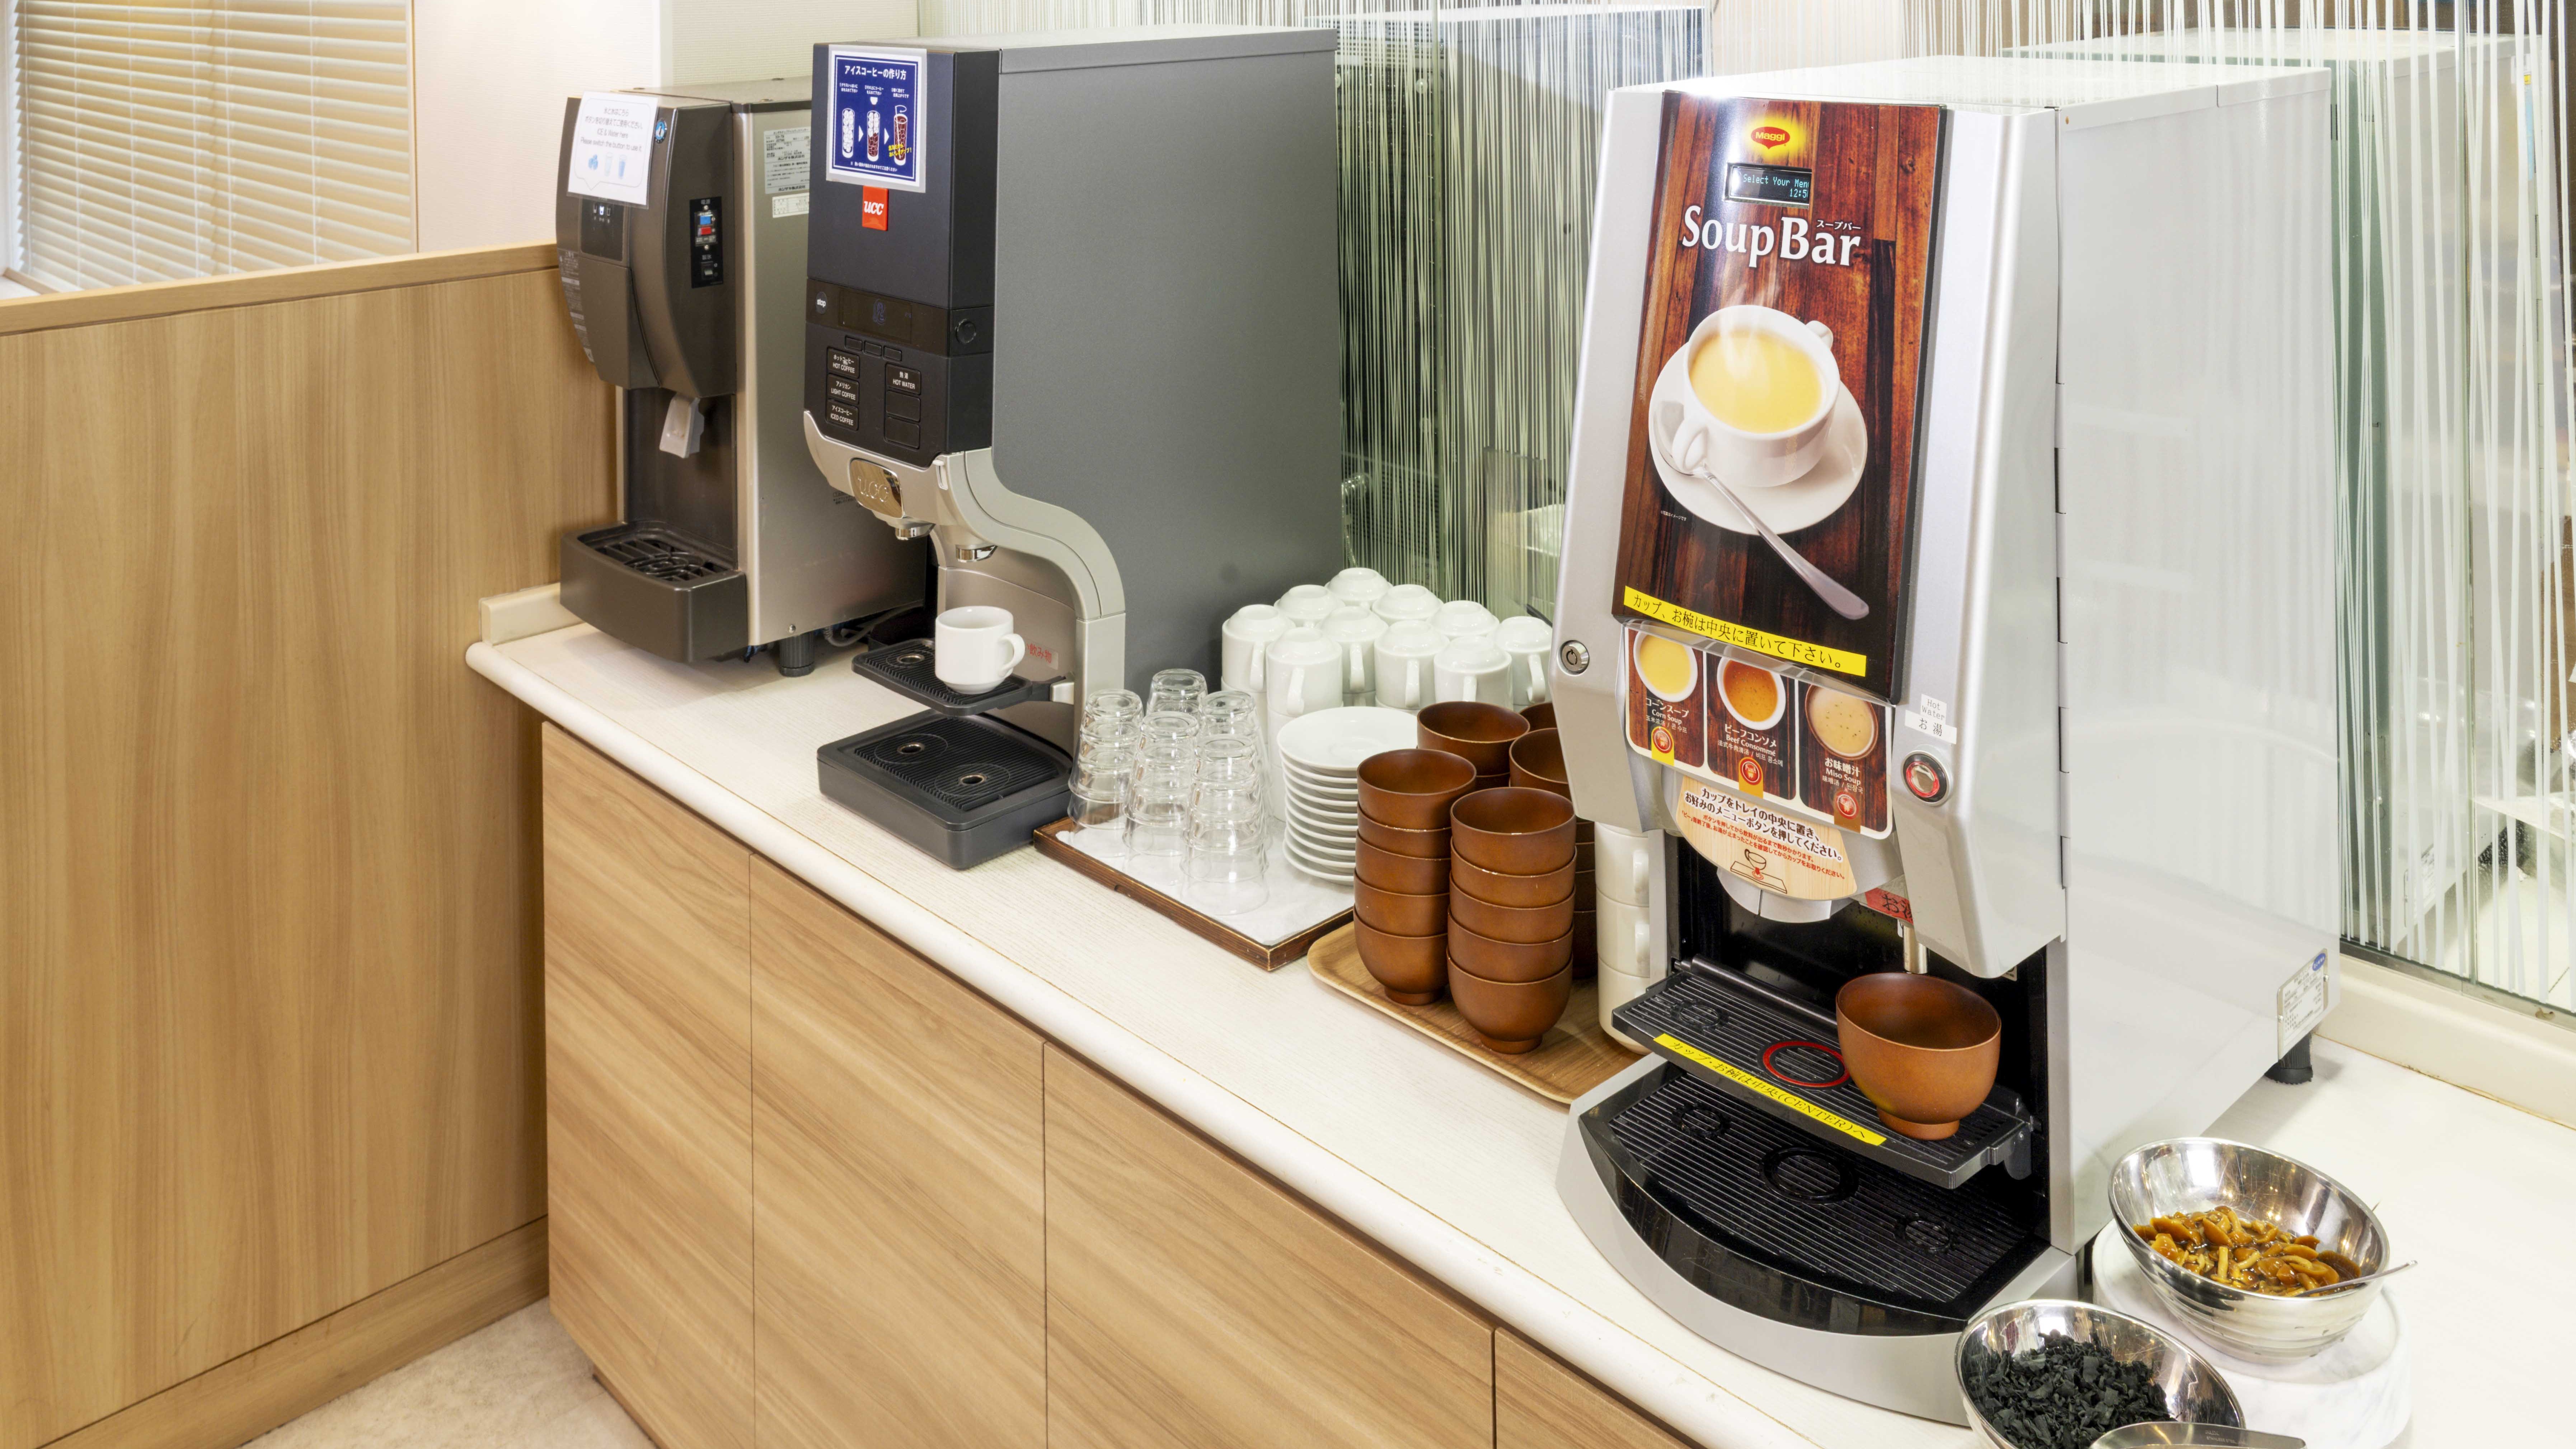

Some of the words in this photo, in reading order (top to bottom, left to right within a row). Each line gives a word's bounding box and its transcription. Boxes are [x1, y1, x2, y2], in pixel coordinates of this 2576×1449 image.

[845, 65, 907, 80] アイスコーヒーの作り方
[1743, 174, 1769, 184] Select
[1773, 176, 1790, 187] Your
[1794, 179, 1809, 188] Men
[1790, 188, 1808, 198] 12:5
[864, 201, 884, 215] UCC
[1816, 220, 1861, 230] スープバー
[1682, 205, 1774, 268] Soup
[1780, 216, 1861, 266] Bar
[817, 299, 826, 308] stop
[833, 354, 854, 364] ホットコーヒー
[841, 365, 855, 373] COFFEE
[836, 381, 851, 390] アメリカン
[901, 381, 915, 389] WATER
[841, 391, 856, 400] COFFEE
[832, 405, 853, 416] アイスコーヒー
[839, 416, 854, 426] COFFEE
[1633, 594, 1841, 669] カップ、お椀は中央に置いて下さい。
[1646, 697, 1689, 718] コーンスープ
[1927, 698, 1941, 711] Hot
[1652, 709, 1666, 719] Corn
[1667, 714, 1682, 725] Soup
[1922, 705, 1945, 720] Water
[1678, 726, 1688, 734] 수프
[1919, 718, 1942, 736] お湯
[1725, 723, 1777, 747] ビーフコンソメ
[1726, 734, 1740, 744] Beef
[1741, 740, 1776, 757] Consommé
[1756, 752, 1766, 761] 비프
[1768, 755, 1783, 768] 콩소메
[1825, 757, 1861, 777] お味噌汁
[1745, 764, 1757, 774] Push
[1826, 768, 1843, 779] Miso
[1844, 774, 1861, 786] Soup
[1702, 788, 1819, 841] カップをトレイの中央に置き、
[1685, 792, 1841, 861] お好みのメニューボタンを押してください。
[1703, 815, 1814, 862] ボタンを押してから飲料が出るまで数秒かかります。
